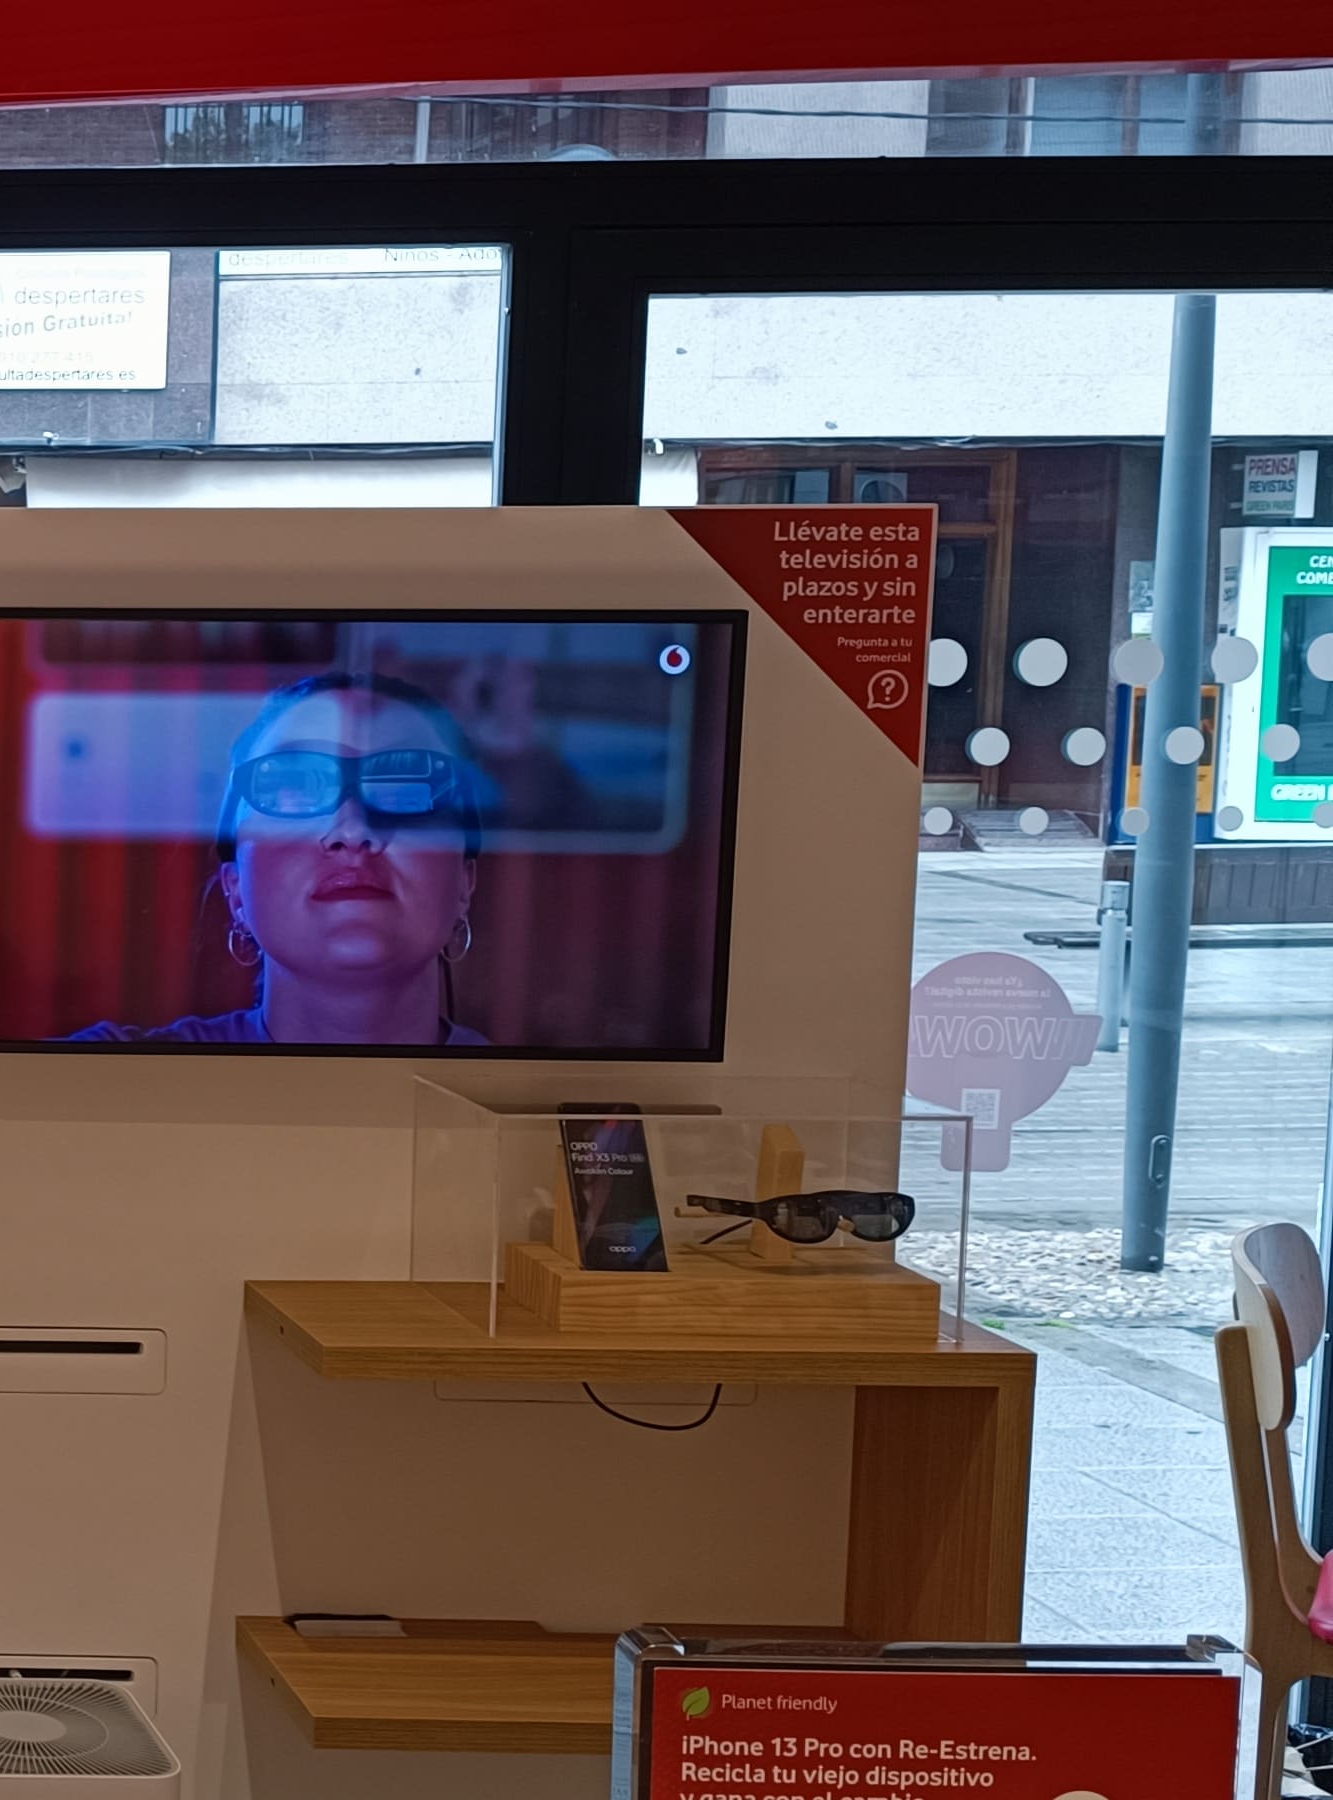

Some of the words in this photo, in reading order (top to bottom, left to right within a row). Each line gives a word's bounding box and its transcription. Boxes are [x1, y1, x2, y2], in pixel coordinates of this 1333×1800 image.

[15, 287, 145, 308] despertares
[43, 309, 133, 333] Gratuita!
[1248, 457, 1297, 476] PRENSA
[1249, 480, 1295, 493] REVISTAS
[774, 520, 863, 541] Llévate
[870, 523, 920, 541] esta
[779, 548, 898, 569] televisión
[905, 554, 918, 569] a
[783, 576, 859, 601] plazos
[863, 581, 879, 601] y
[883, 577, 916, 596] sin
[803, 605, 916, 624] enterarte
[837, 636, 889, 649] Pregunta
[900, 637, 913, 647] tu
[856, 653, 911, 662] comercial
[570, 1142, 598, 1151] OPPO
[571, 1153, 594, 1163] Find
[596, 1153, 610, 1162] X3
[612, 1153, 628, 1162] Pro
[721, 1694, 773, 1710] Planet
[777, 1694, 838, 1713] friendly
[682, 1736, 764, 1756] iPhone
[771, 1737, 797, 1757] 13
[804, 1738, 843, 1757] Pro
[849, 1744, 892, 1758] con
[899, 1740, 1037, 1762] Re-Estrena.
[681, 1762, 766, 1783] Recicla
[772, 1766, 796, 1784] tu
[803, 1764, 859, 1789] viejo
[865, 1766, 994, 1790] dispositivo
